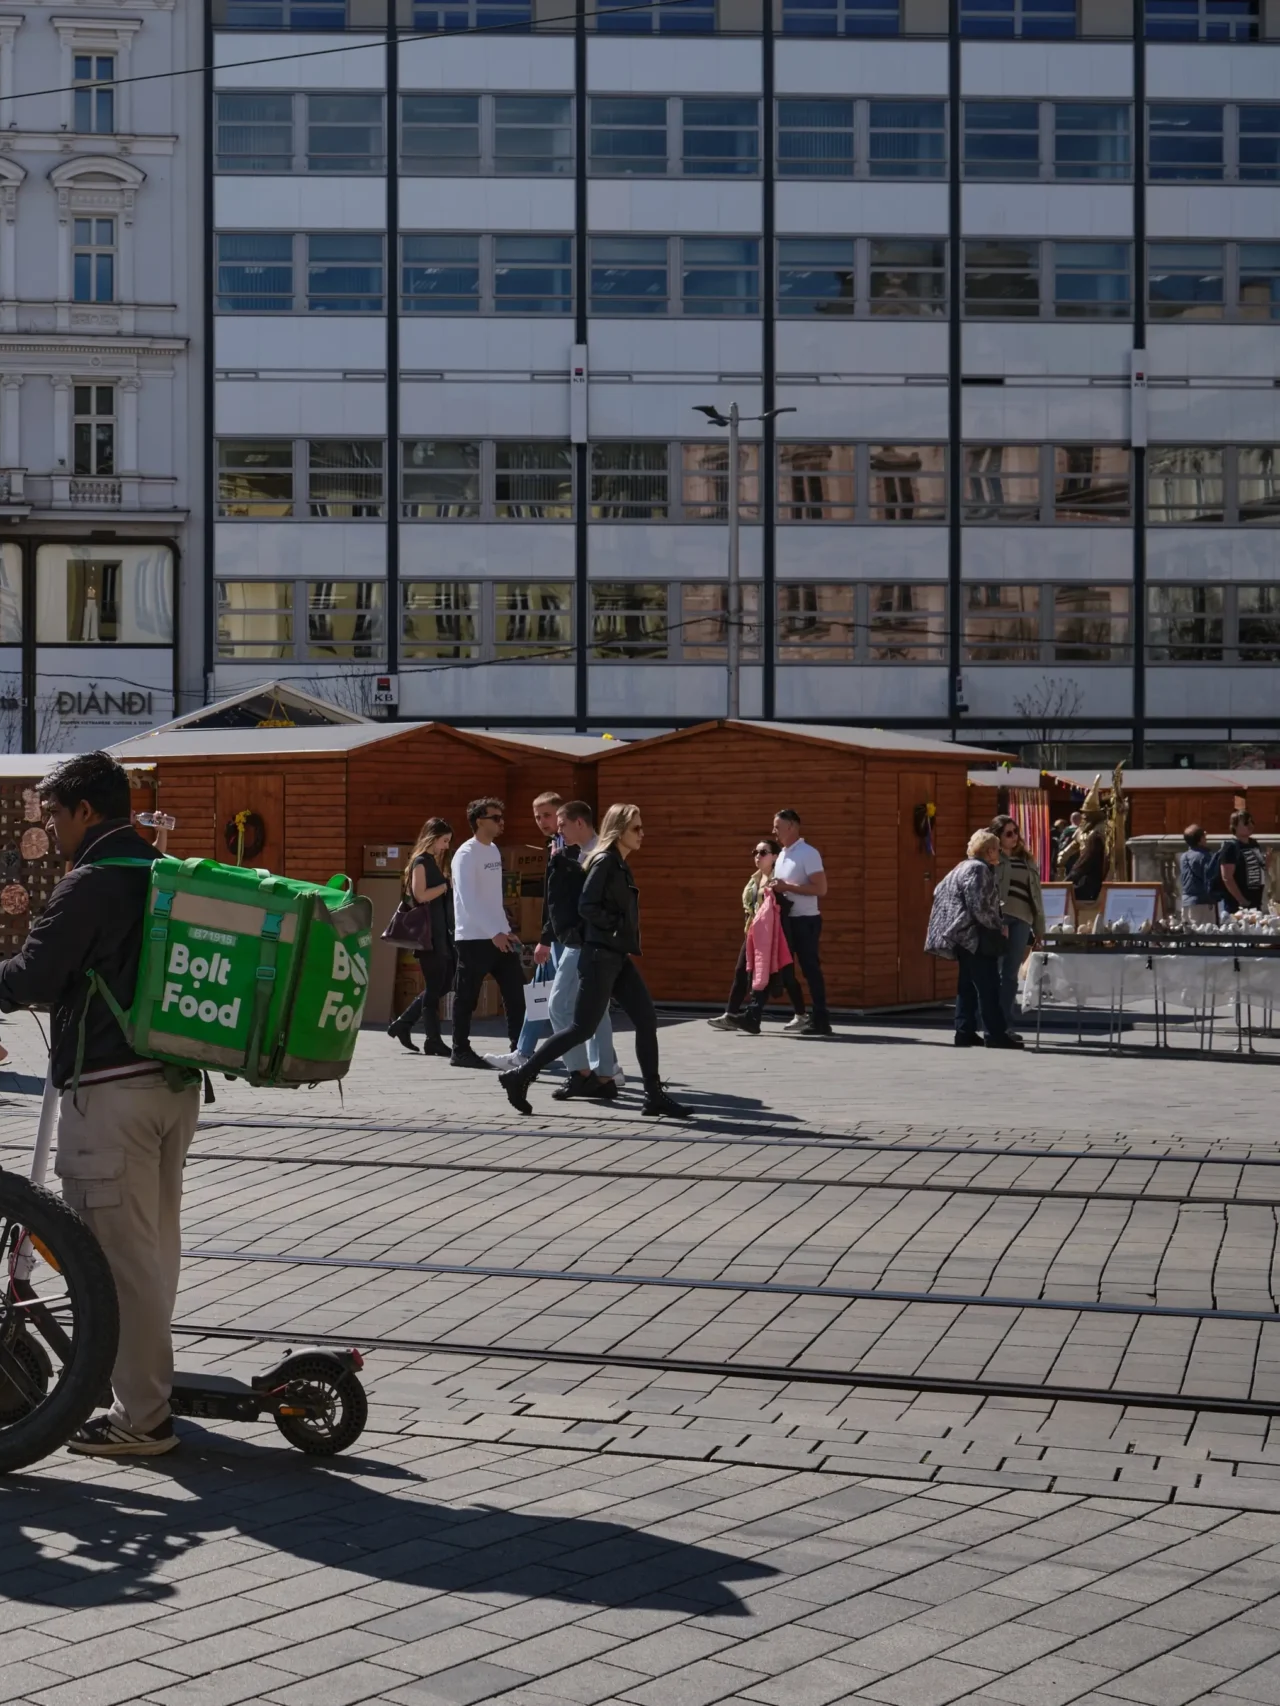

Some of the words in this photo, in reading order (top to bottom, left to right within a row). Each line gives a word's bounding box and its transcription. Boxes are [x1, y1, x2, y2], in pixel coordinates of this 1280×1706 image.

[374, 694, 393, 702] KB
[168, 942, 232, 988] Bolt
[161, 981, 242, 1029] Food
